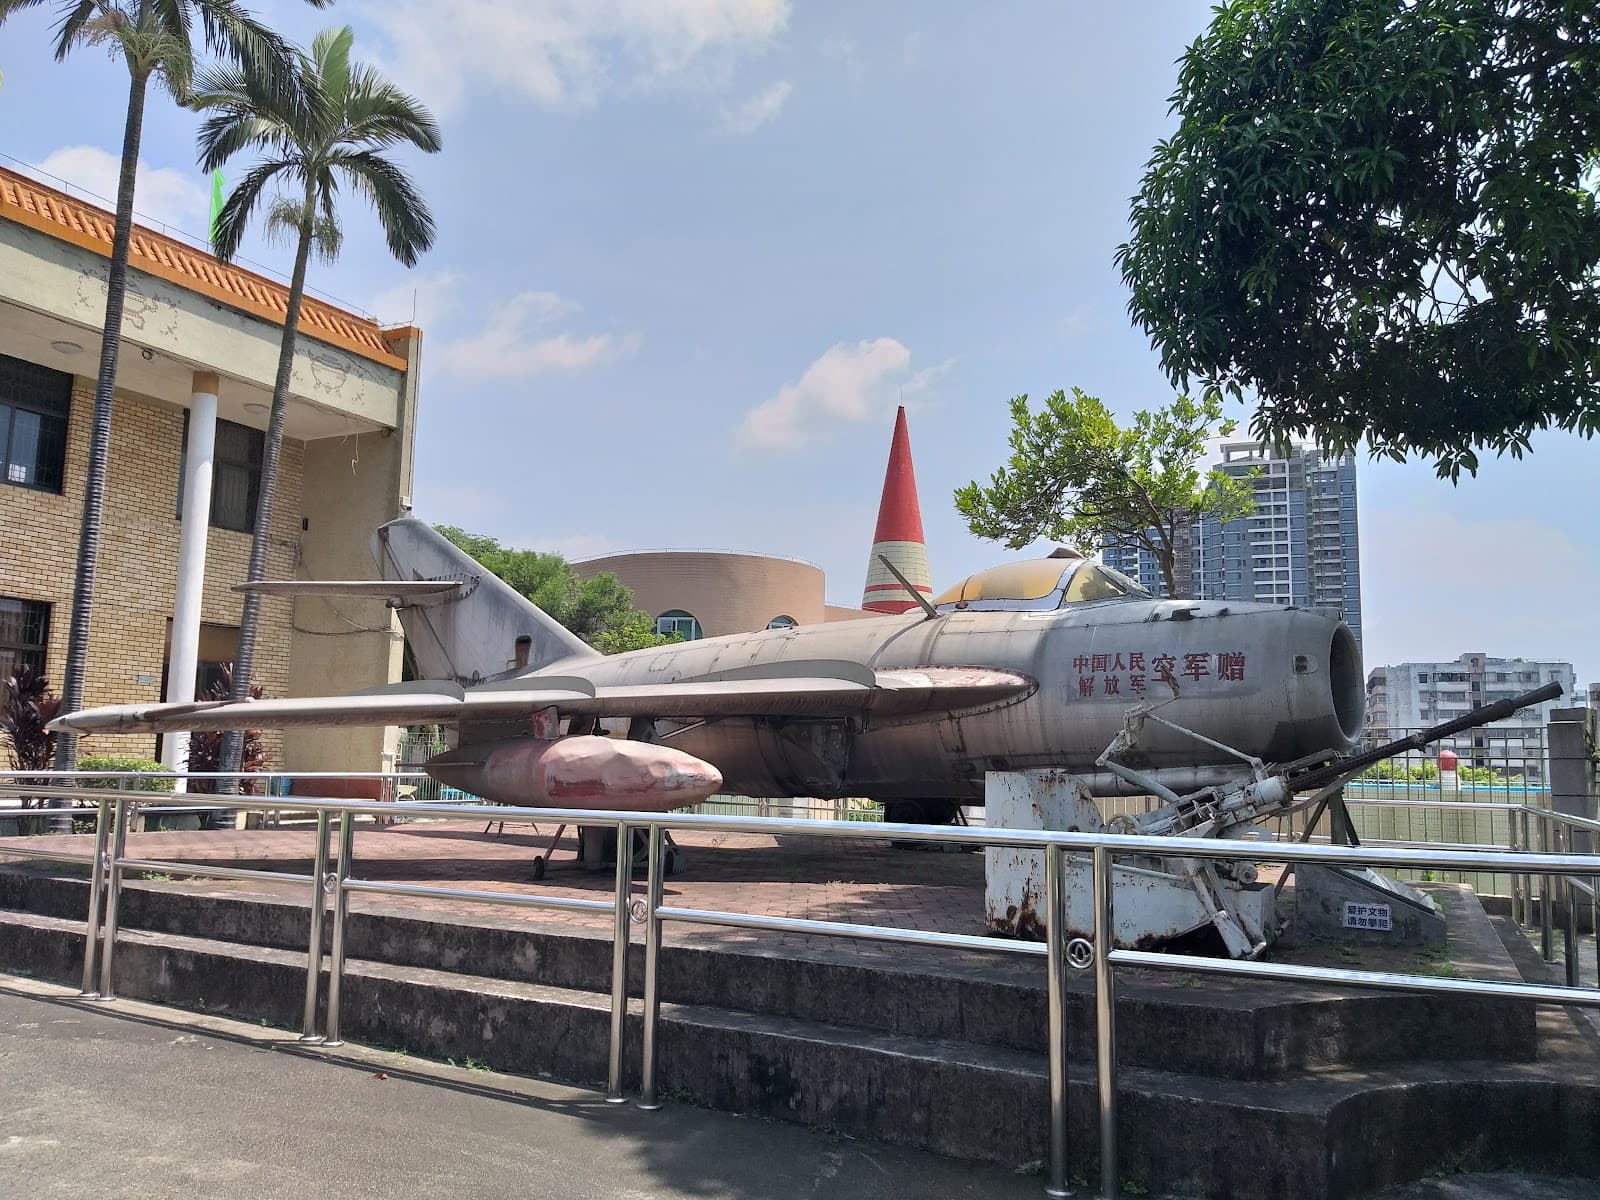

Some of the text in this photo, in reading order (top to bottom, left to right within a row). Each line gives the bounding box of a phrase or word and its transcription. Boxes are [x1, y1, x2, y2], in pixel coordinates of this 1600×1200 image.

[1072, 652, 1146, 673] 中国人民
[1151, 651, 1247, 682] 空军赠
[1078, 674, 1147, 696] 解放军
[1347, 905, 1388, 917] 爱护文物
[1347, 916, 1389, 928] 请勿攀爬
